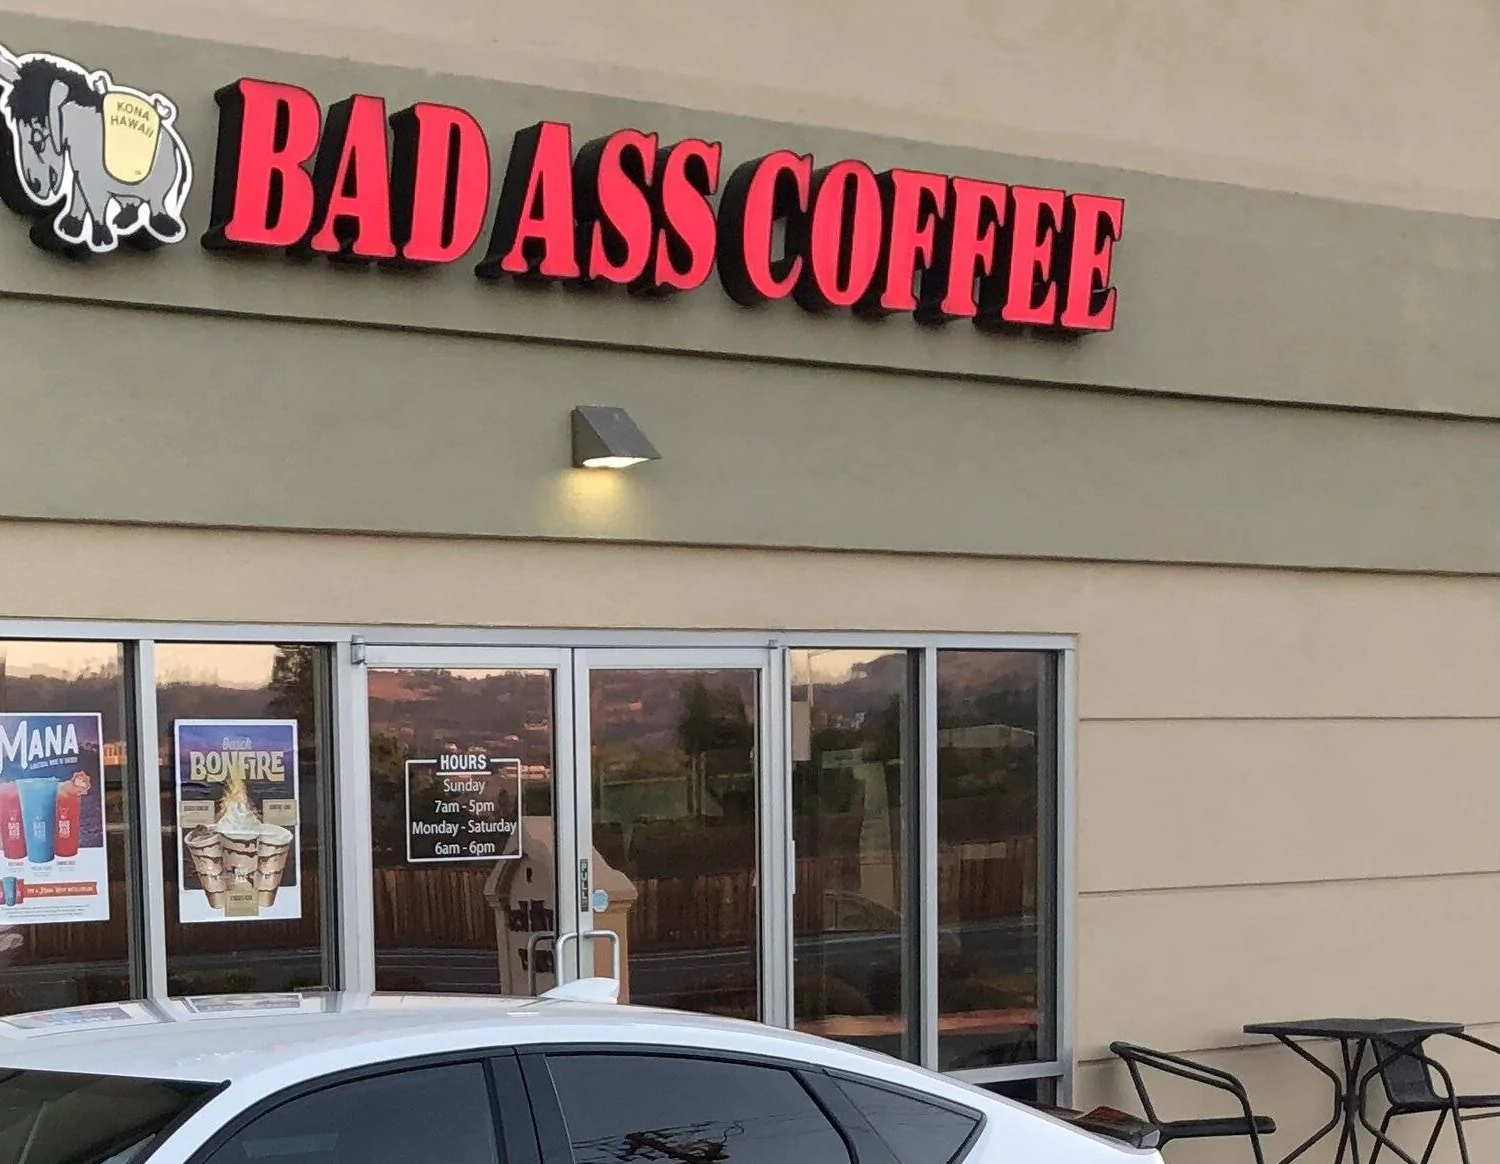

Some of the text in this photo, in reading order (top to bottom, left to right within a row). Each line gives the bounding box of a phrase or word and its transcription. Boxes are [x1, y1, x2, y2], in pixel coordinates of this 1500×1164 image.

[116, 101, 150, 121] KONA
[110, 115, 154, 138] HAWAII
[222, 76, 1127, 333] BAD ASS COFFEE
[189, 750, 285, 782] BONFIRE
[440, 754, 487, 770] HOURS
[443, 778, 485, 795] Sunday
[435, 800, 460, 814] 7am
[469, 800, 495, 815] 5pm
[412, 822, 459, 837] Monday
[467, 820, 517, 836] Saturday
[435, 842, 460, 855] 6am
[469, 841, 495, 856] 6pm
